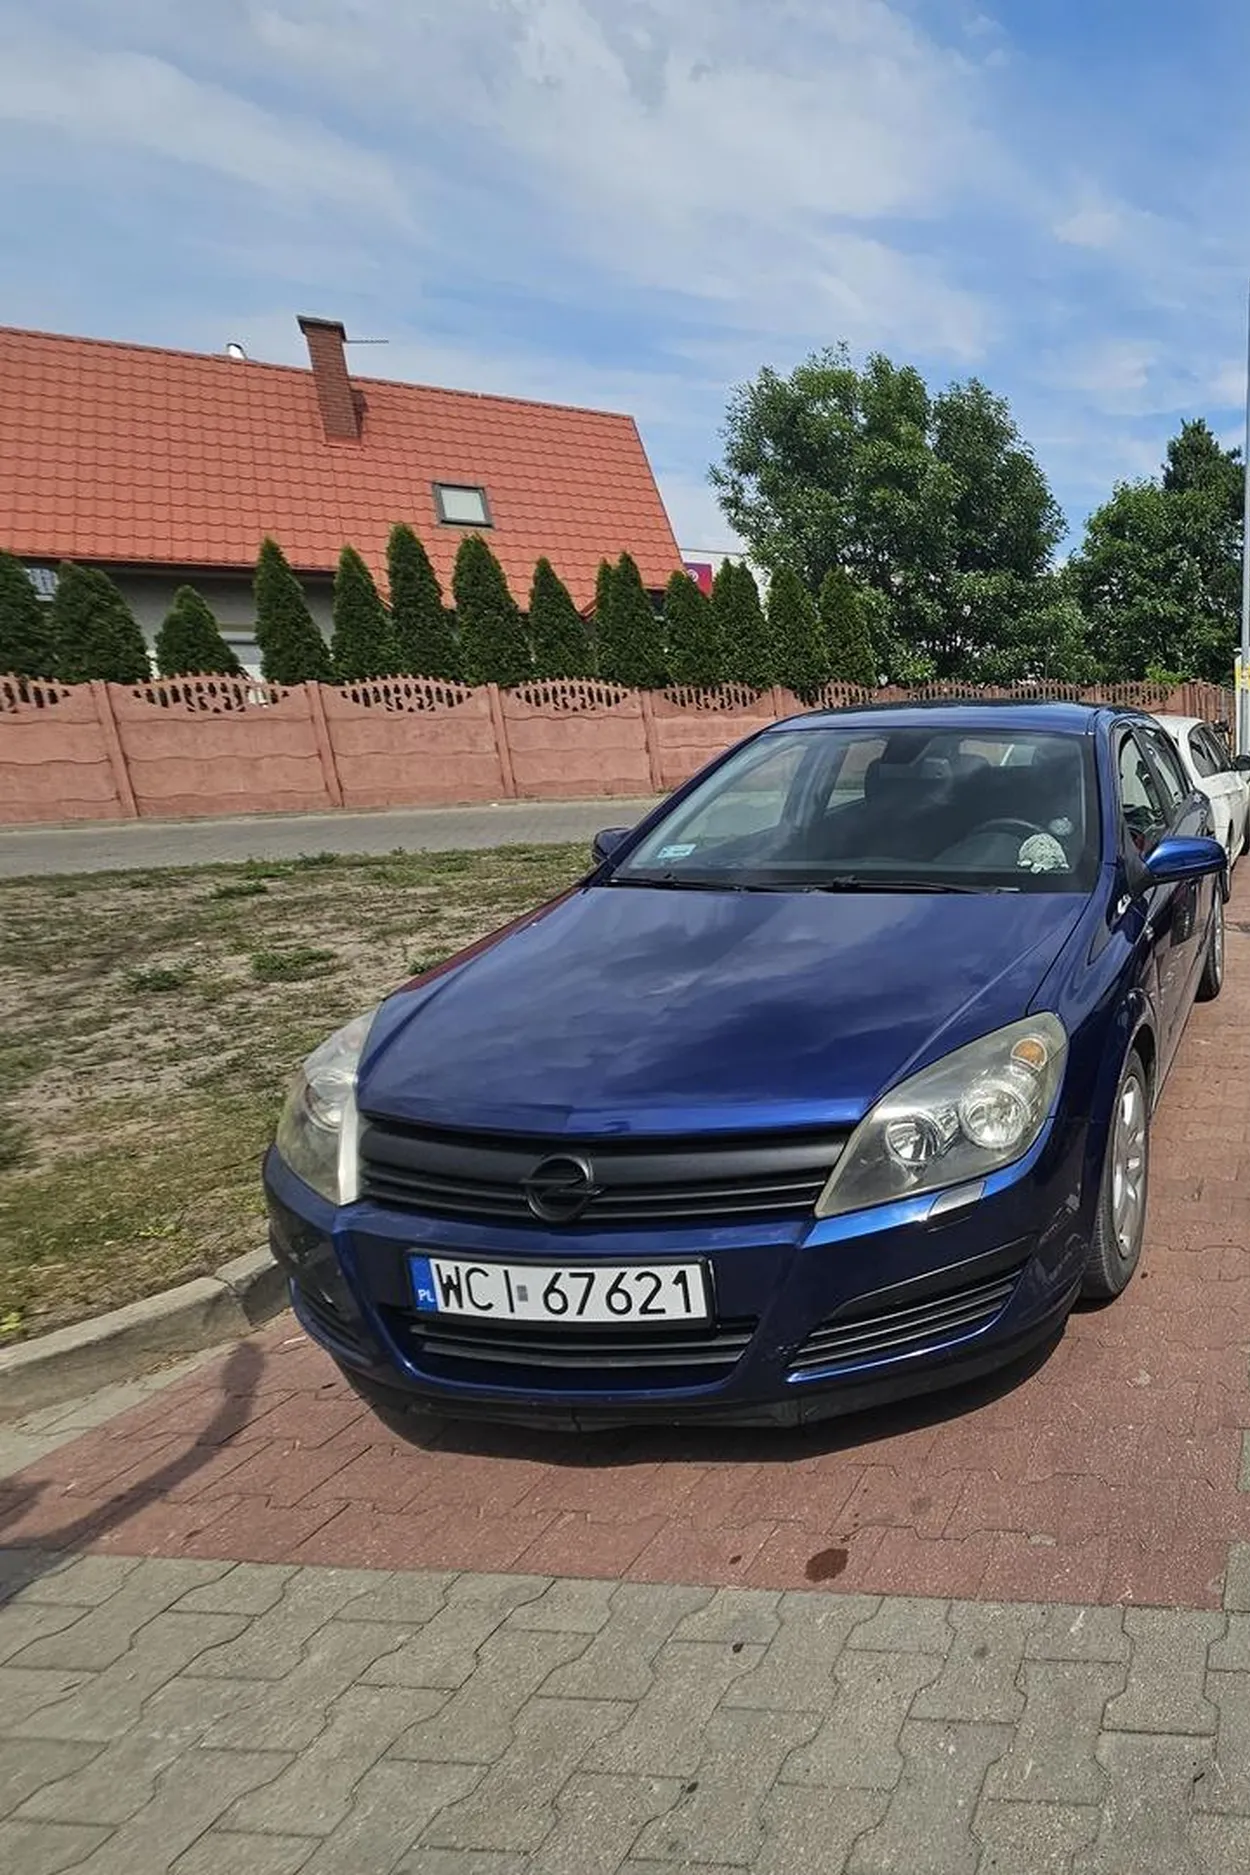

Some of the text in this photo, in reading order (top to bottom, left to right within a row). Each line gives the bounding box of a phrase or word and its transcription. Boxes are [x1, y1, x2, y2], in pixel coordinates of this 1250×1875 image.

[417, 1288, 435, 1303] PL
[435, 1263, 692, 1316] WCI 67621
